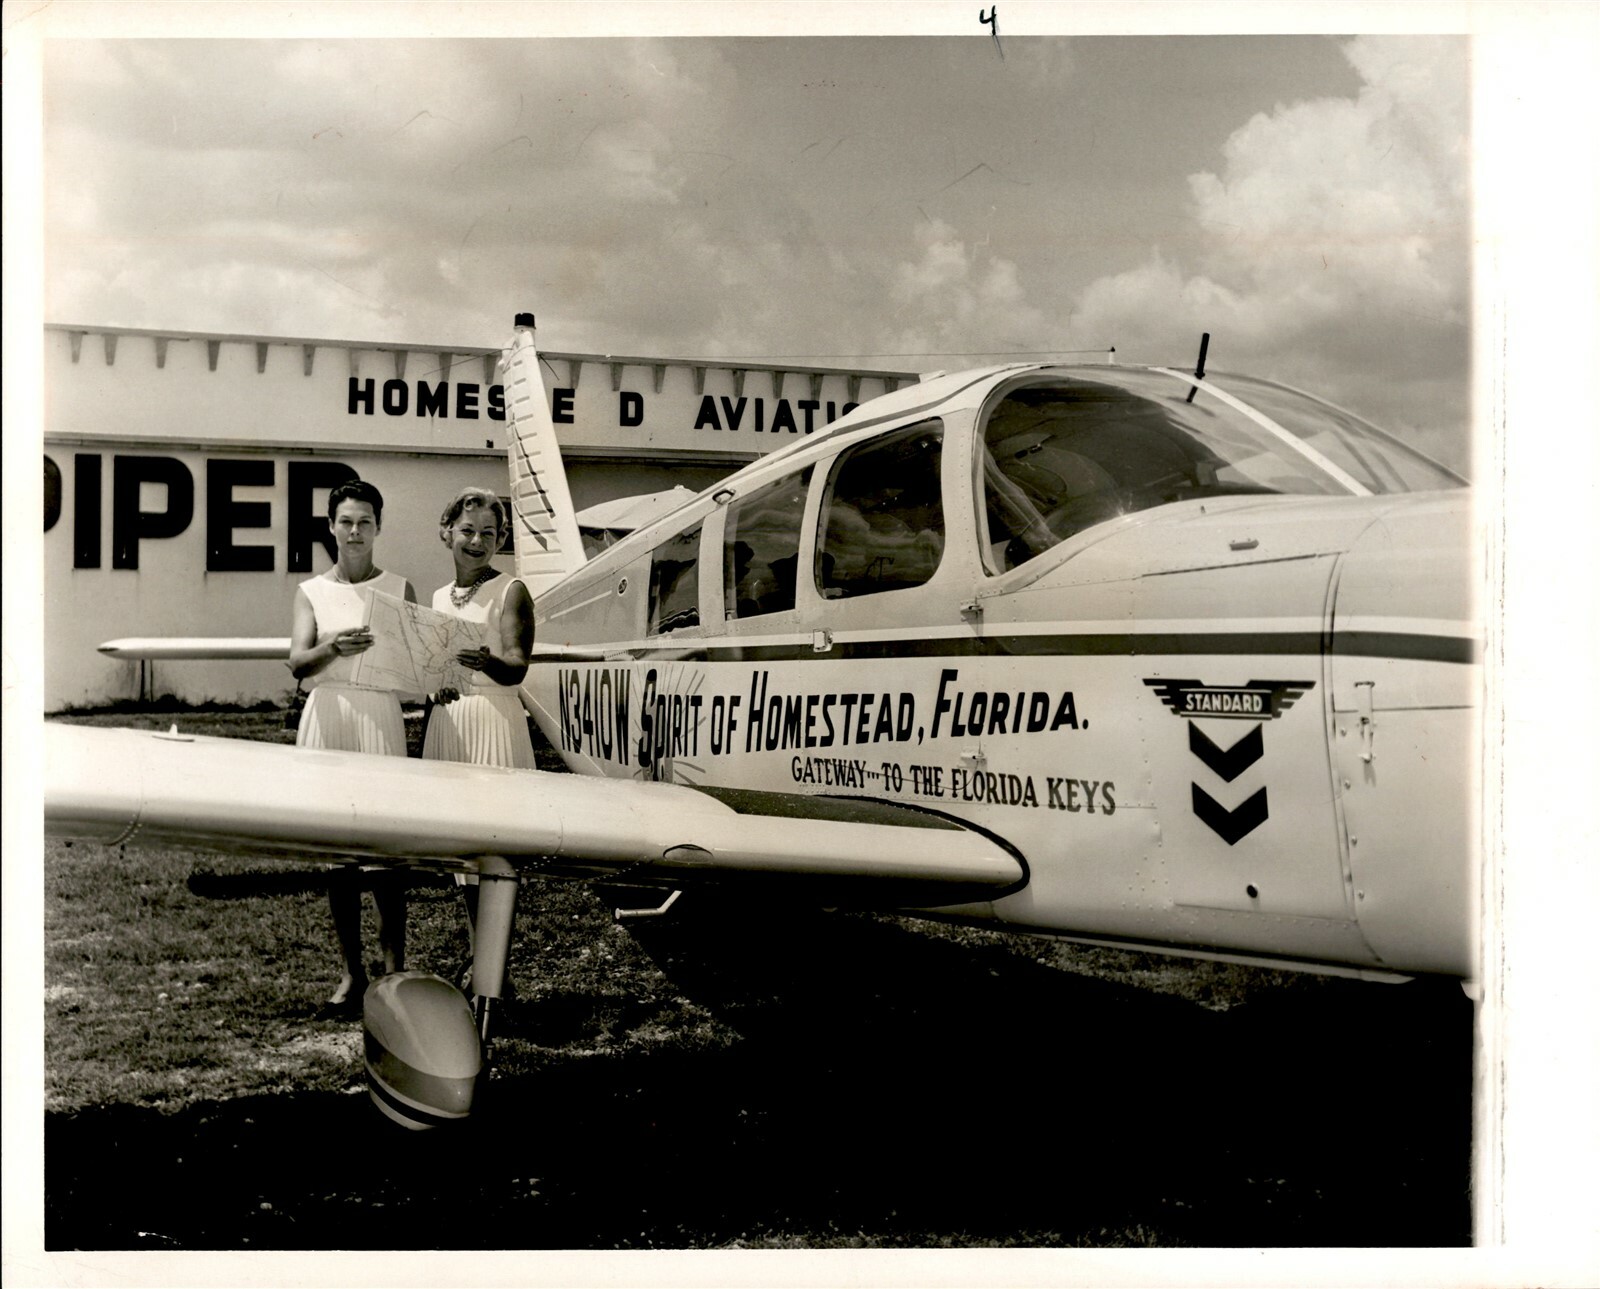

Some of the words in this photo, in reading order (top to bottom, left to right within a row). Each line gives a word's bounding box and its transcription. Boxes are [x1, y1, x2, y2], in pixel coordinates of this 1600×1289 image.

[694, 394, 860, 434] AVIATI
[43, 453, 361, 573] IPER
[558, 669, 631, 766] N3410W
[710, 695, 741, 755] OF
[745, 670, 925, 753] HOMESTEAD,
[930, 668, 1090, 739] FLORIDA.
[1185, 693, 1263, 712] STANDARD
[881, 762, 902, 792] TO
[910, 765, 944, 796] THE
[951, 768, 1039, 807] FLORIDA
[1046, 777, 1116, 815] KEYS
